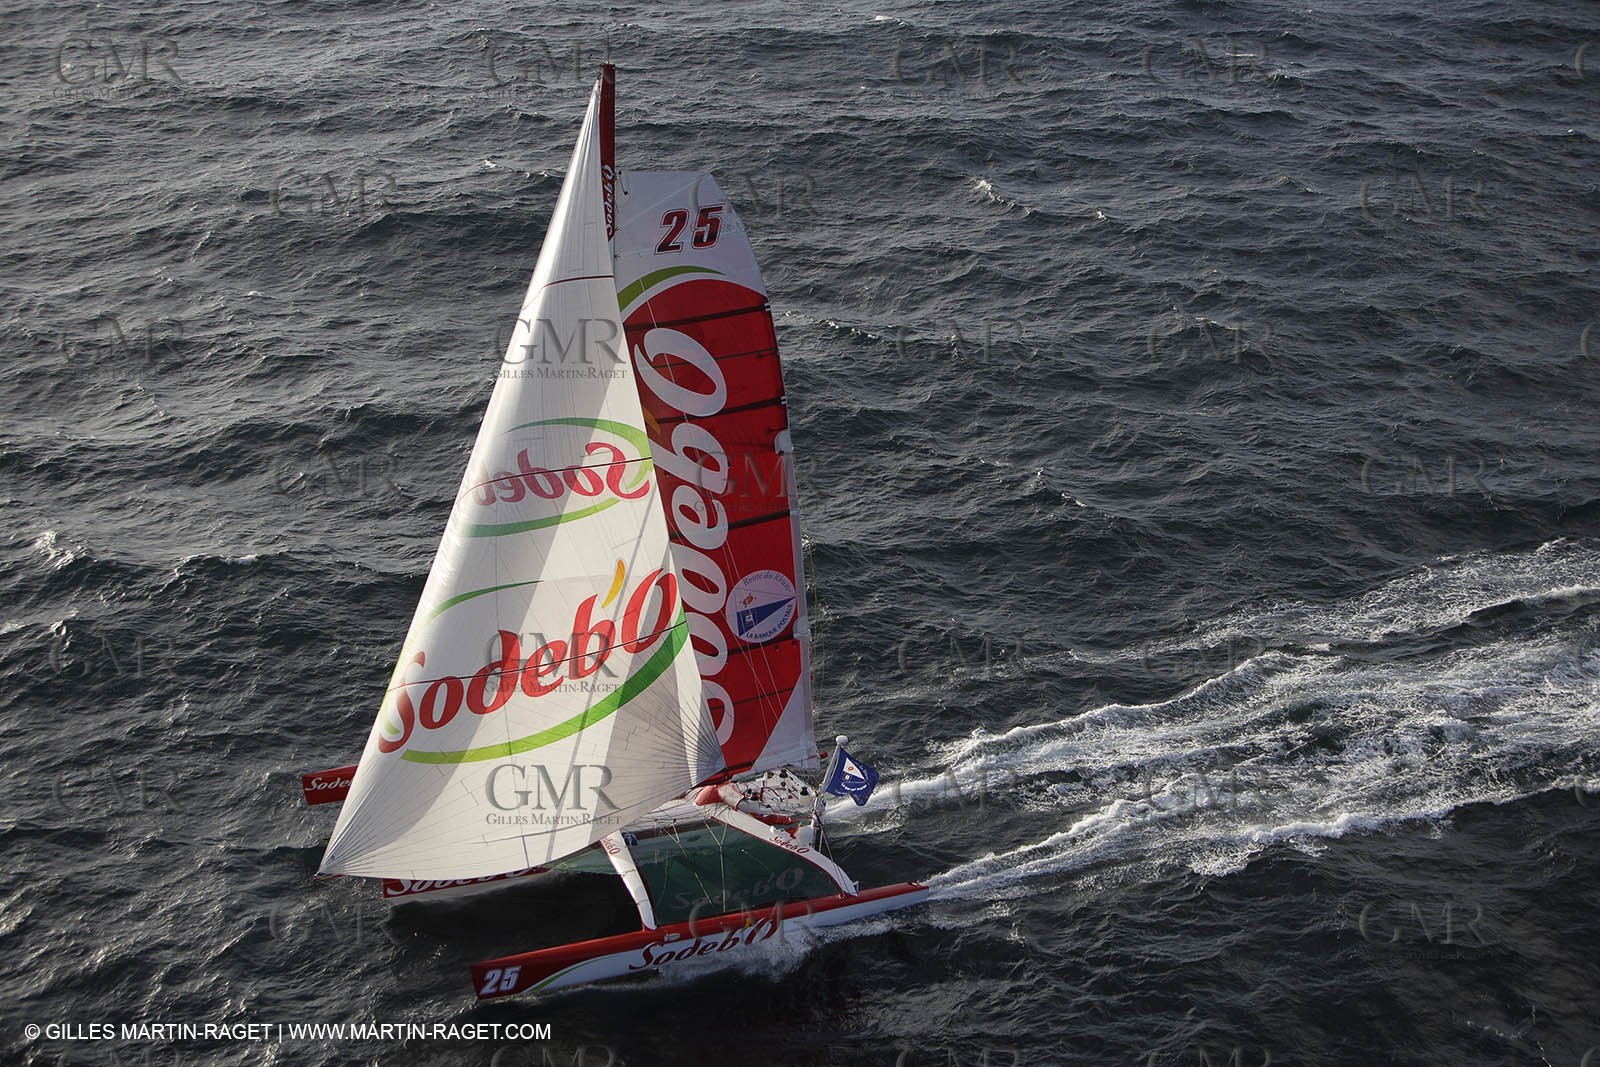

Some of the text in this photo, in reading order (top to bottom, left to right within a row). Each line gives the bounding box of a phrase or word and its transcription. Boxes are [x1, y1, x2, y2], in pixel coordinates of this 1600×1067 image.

[654, 203, 725, 256] 25
[378, 559, 677, 754] Sodeb'O
[628, 916, 779, 971] Sodeb'O
[479, 965, 523, 996] 25
